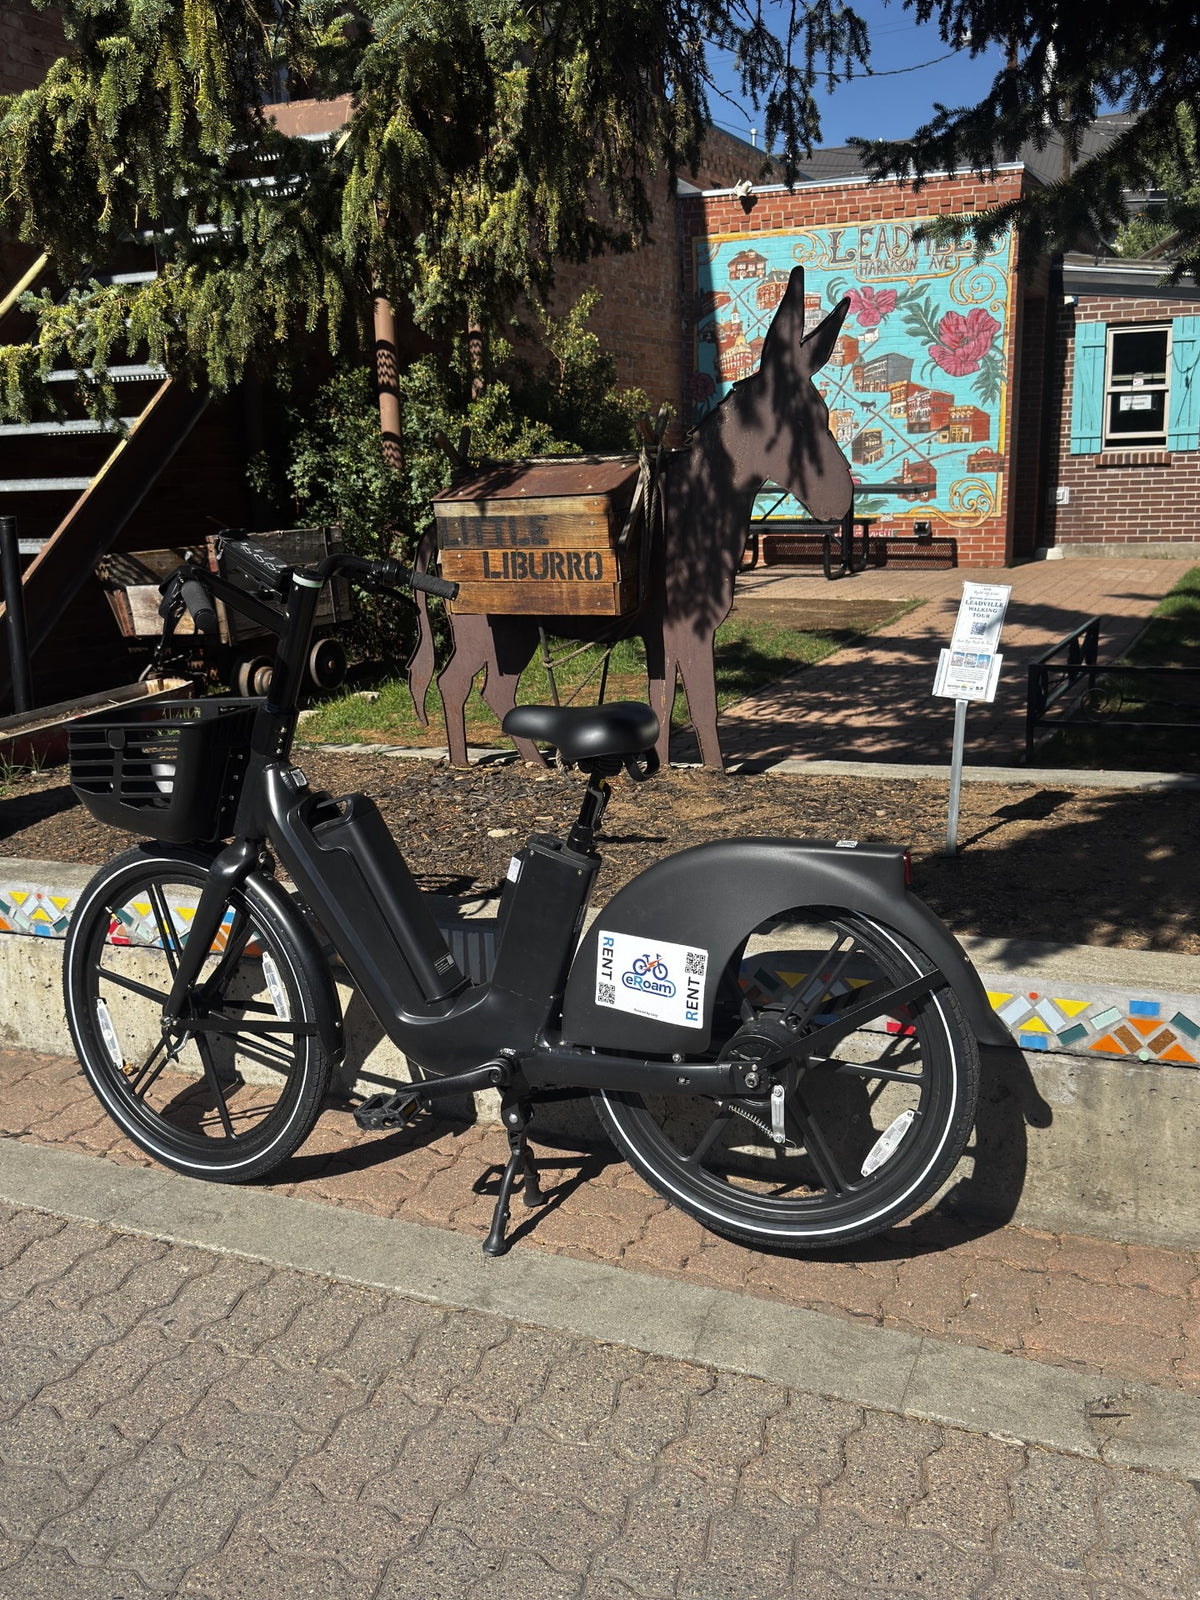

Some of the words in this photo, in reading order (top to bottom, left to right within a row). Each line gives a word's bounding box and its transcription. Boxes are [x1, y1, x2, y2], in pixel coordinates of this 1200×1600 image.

[859, 259, 918, 277] HARRISON
[928, 255, 954, 271] AVE
[442, 514, 549, 546] LITTLE
[482, 551, 603, 581] LIBURRO
[965, 600, 1004, 608] LEADVILLE
[602, 937, 614, 980] RENT
[625, 975, 672, 994] eRoam
[685, 977, 699, 1021] RENT
